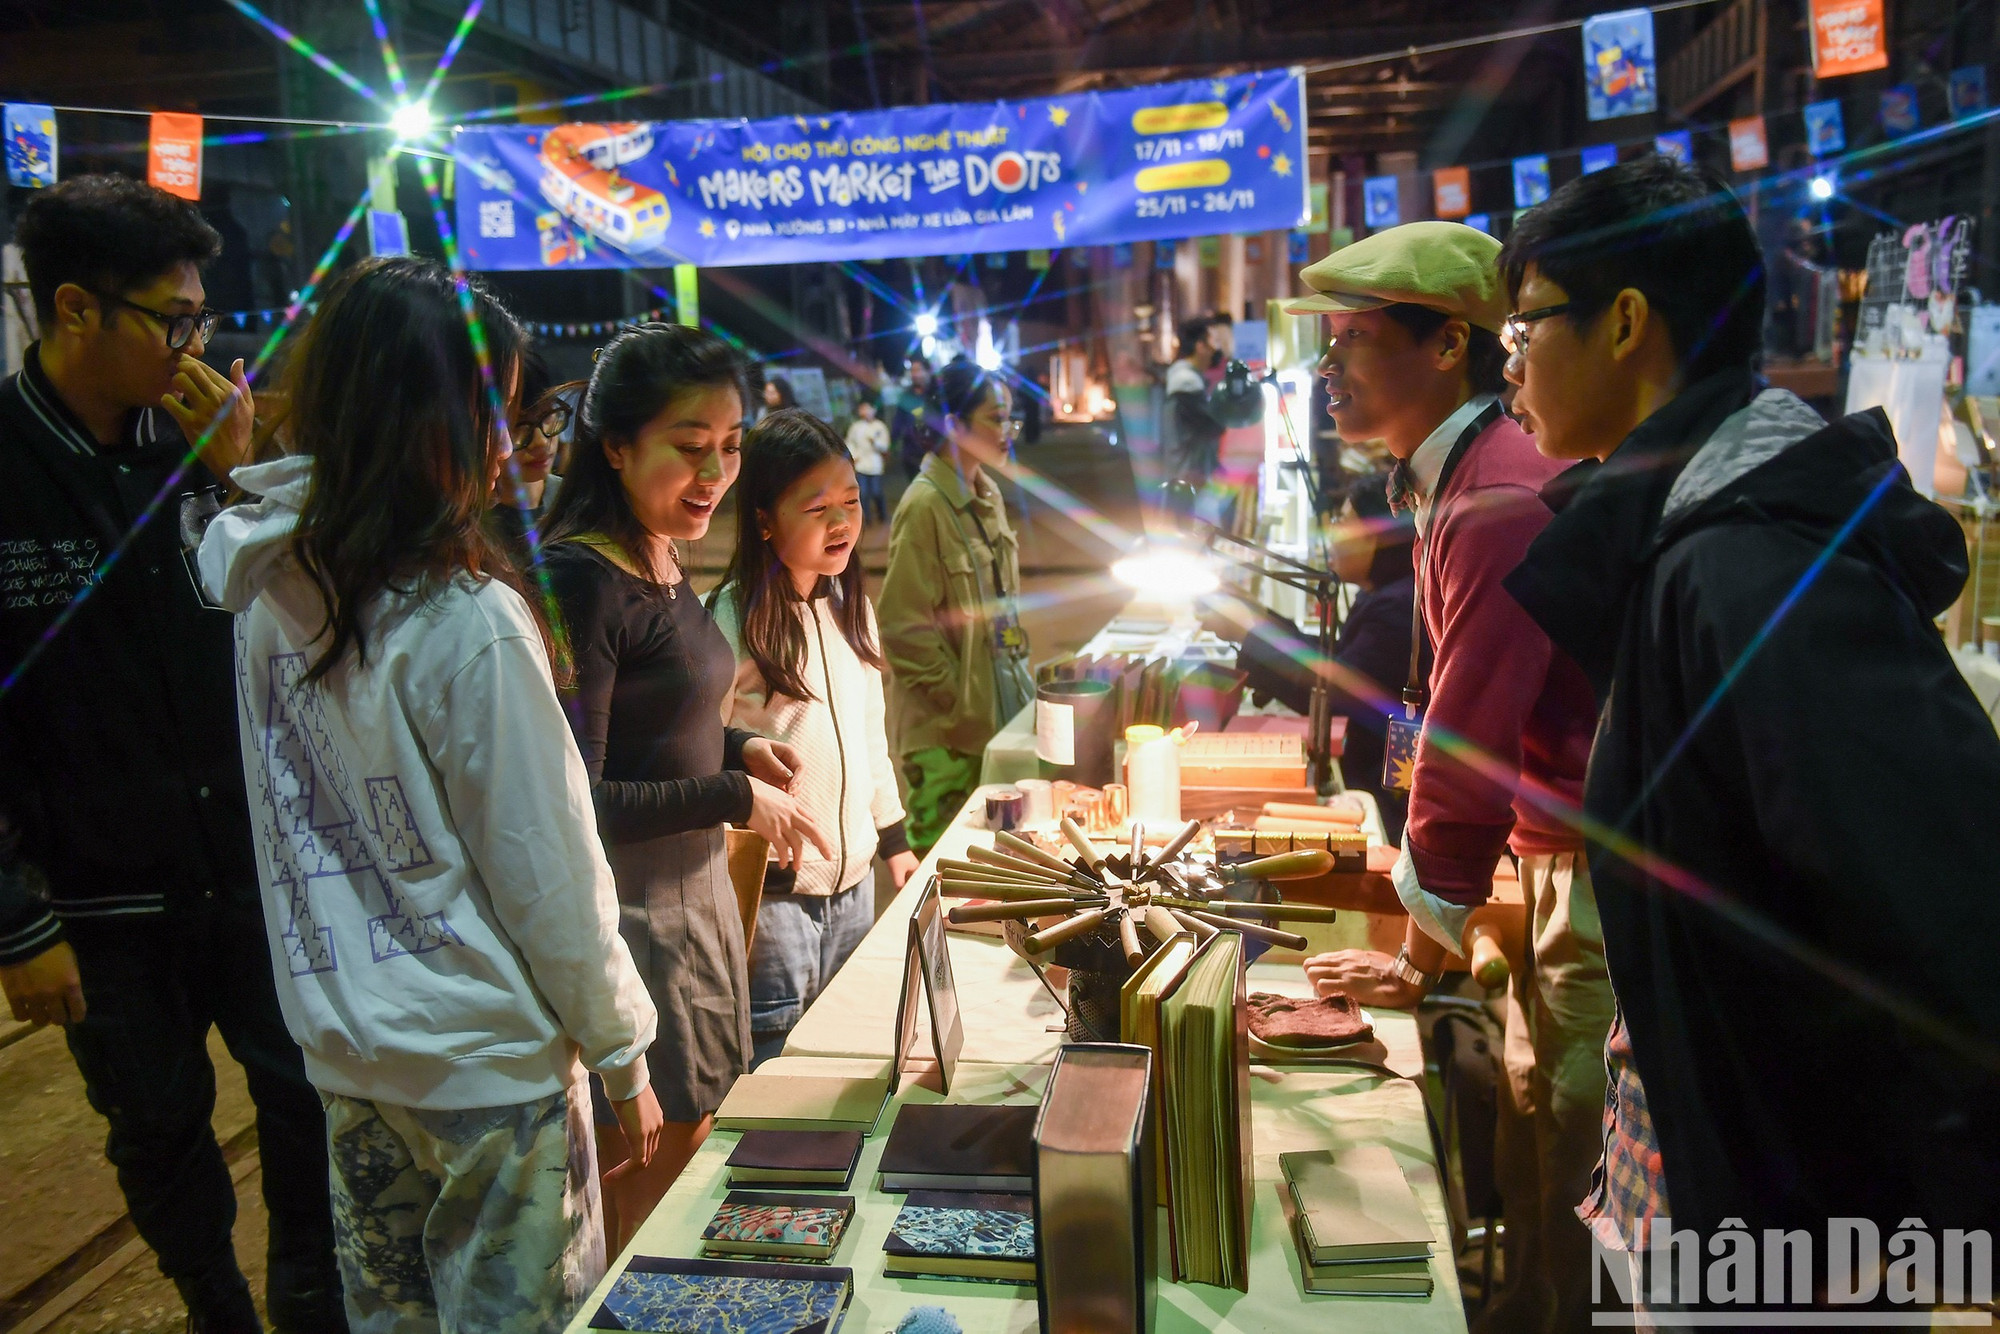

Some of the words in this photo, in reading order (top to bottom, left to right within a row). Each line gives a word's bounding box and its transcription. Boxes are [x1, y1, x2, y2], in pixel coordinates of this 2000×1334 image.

[851, 135, 900, 156] CÔNG
[1134, 138, 1182, 162] 17/11
[1197, 128, 1244, 152] 18/11
[964, 150, 1061, 197] DOTS
[1136, 195, 1187, 218] 25/11
[1204, 189, 1255, 213] 26/11
